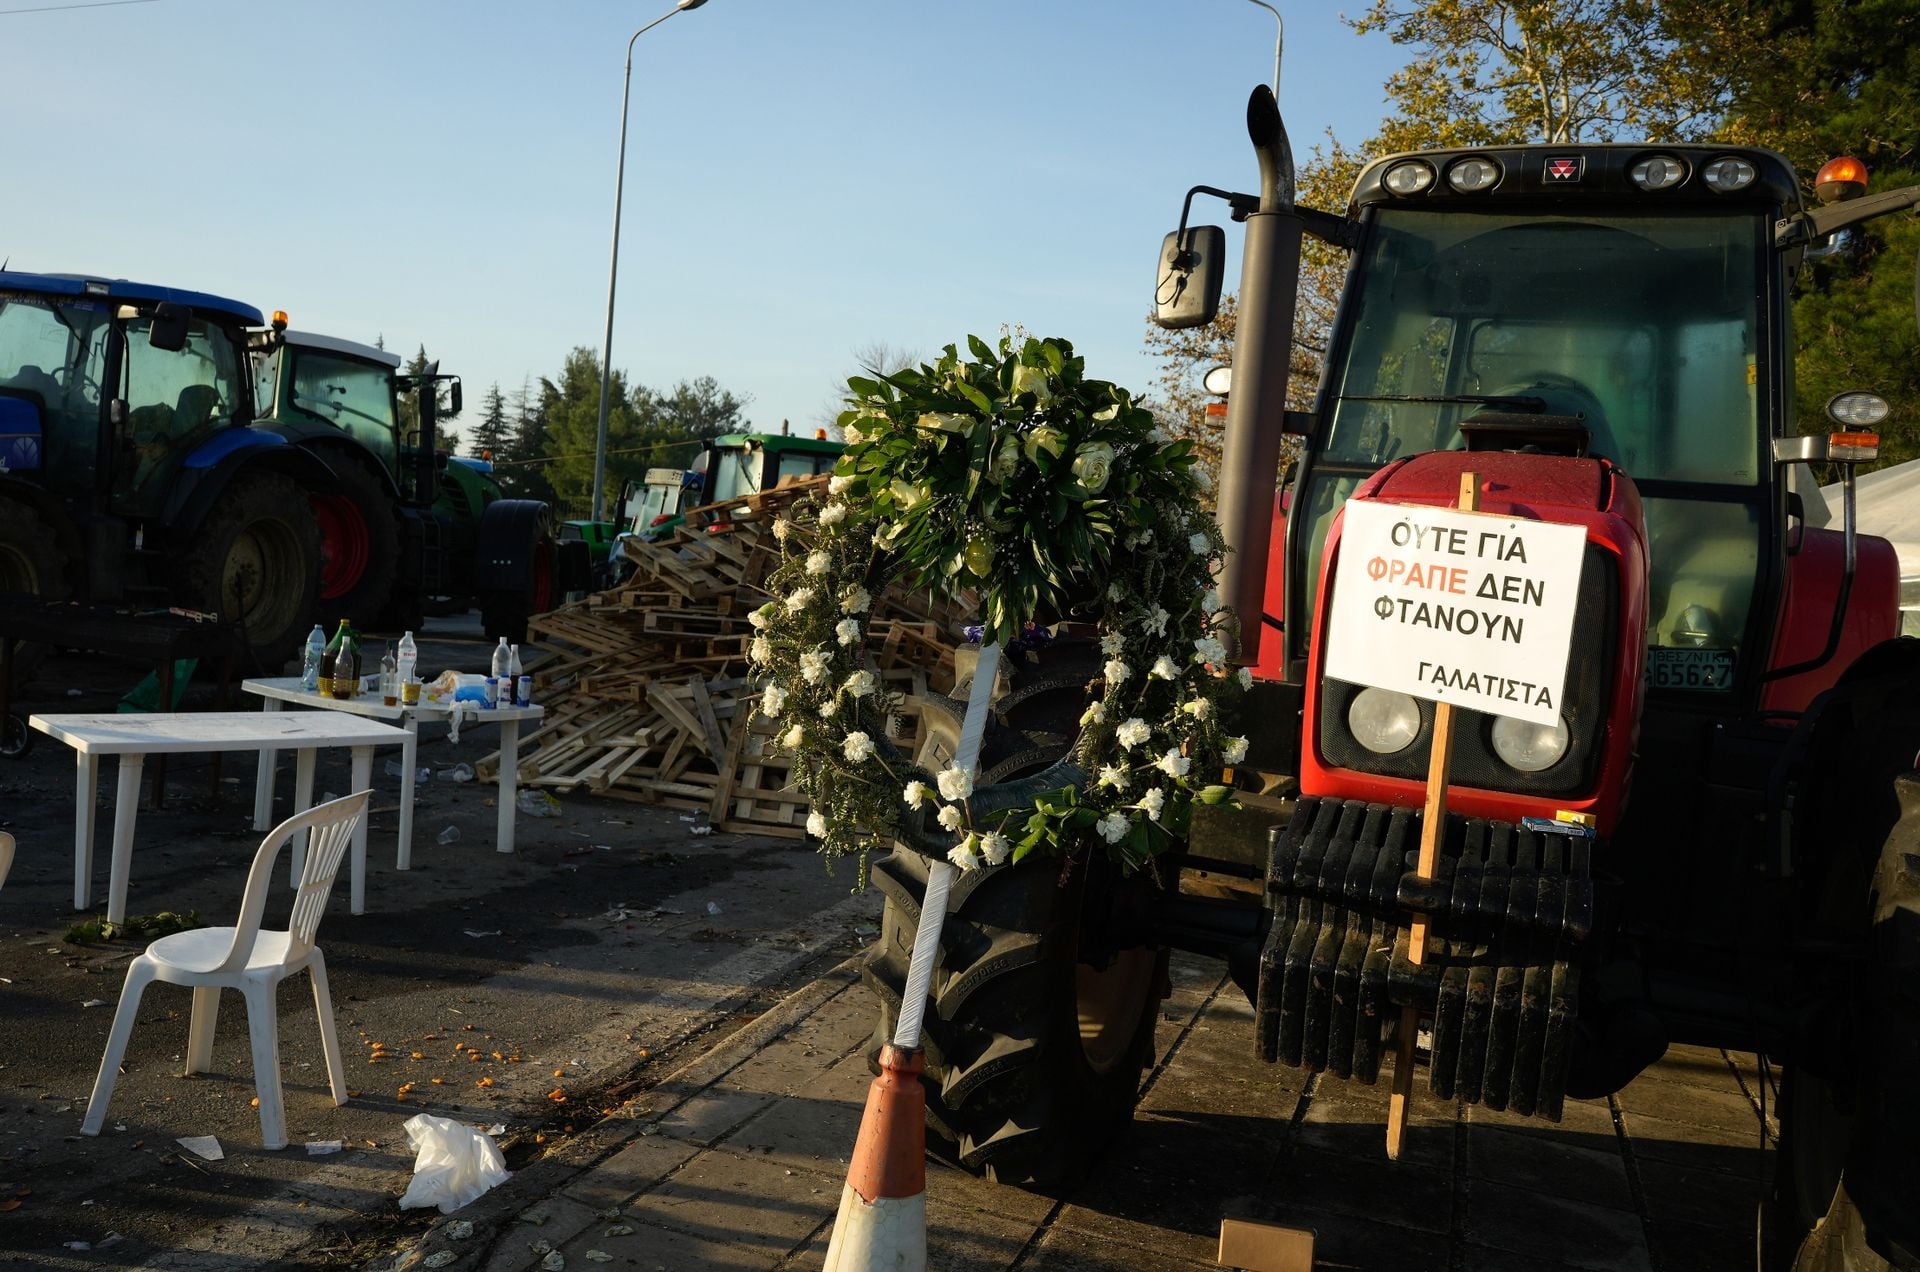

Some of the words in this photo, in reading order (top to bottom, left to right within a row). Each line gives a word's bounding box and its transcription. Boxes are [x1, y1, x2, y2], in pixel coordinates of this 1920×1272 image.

[1391, 521, 1468, 555] ΟΥΤΕ
[1477, 533, 1527, 563] ΓΙΑ
[1366, 556, 1468, 595] ΦΡΑΠΕ
[1476, 573, 1544, 607] ΔΕΝ
[1374, 595, 1524, 644] ΦΤΑΝΟΥΝ
[1417, 661, 1553, 709] ΓΑΛΑΤΙΣΤΑ
[1656, 663, 1730, 686] 65627
